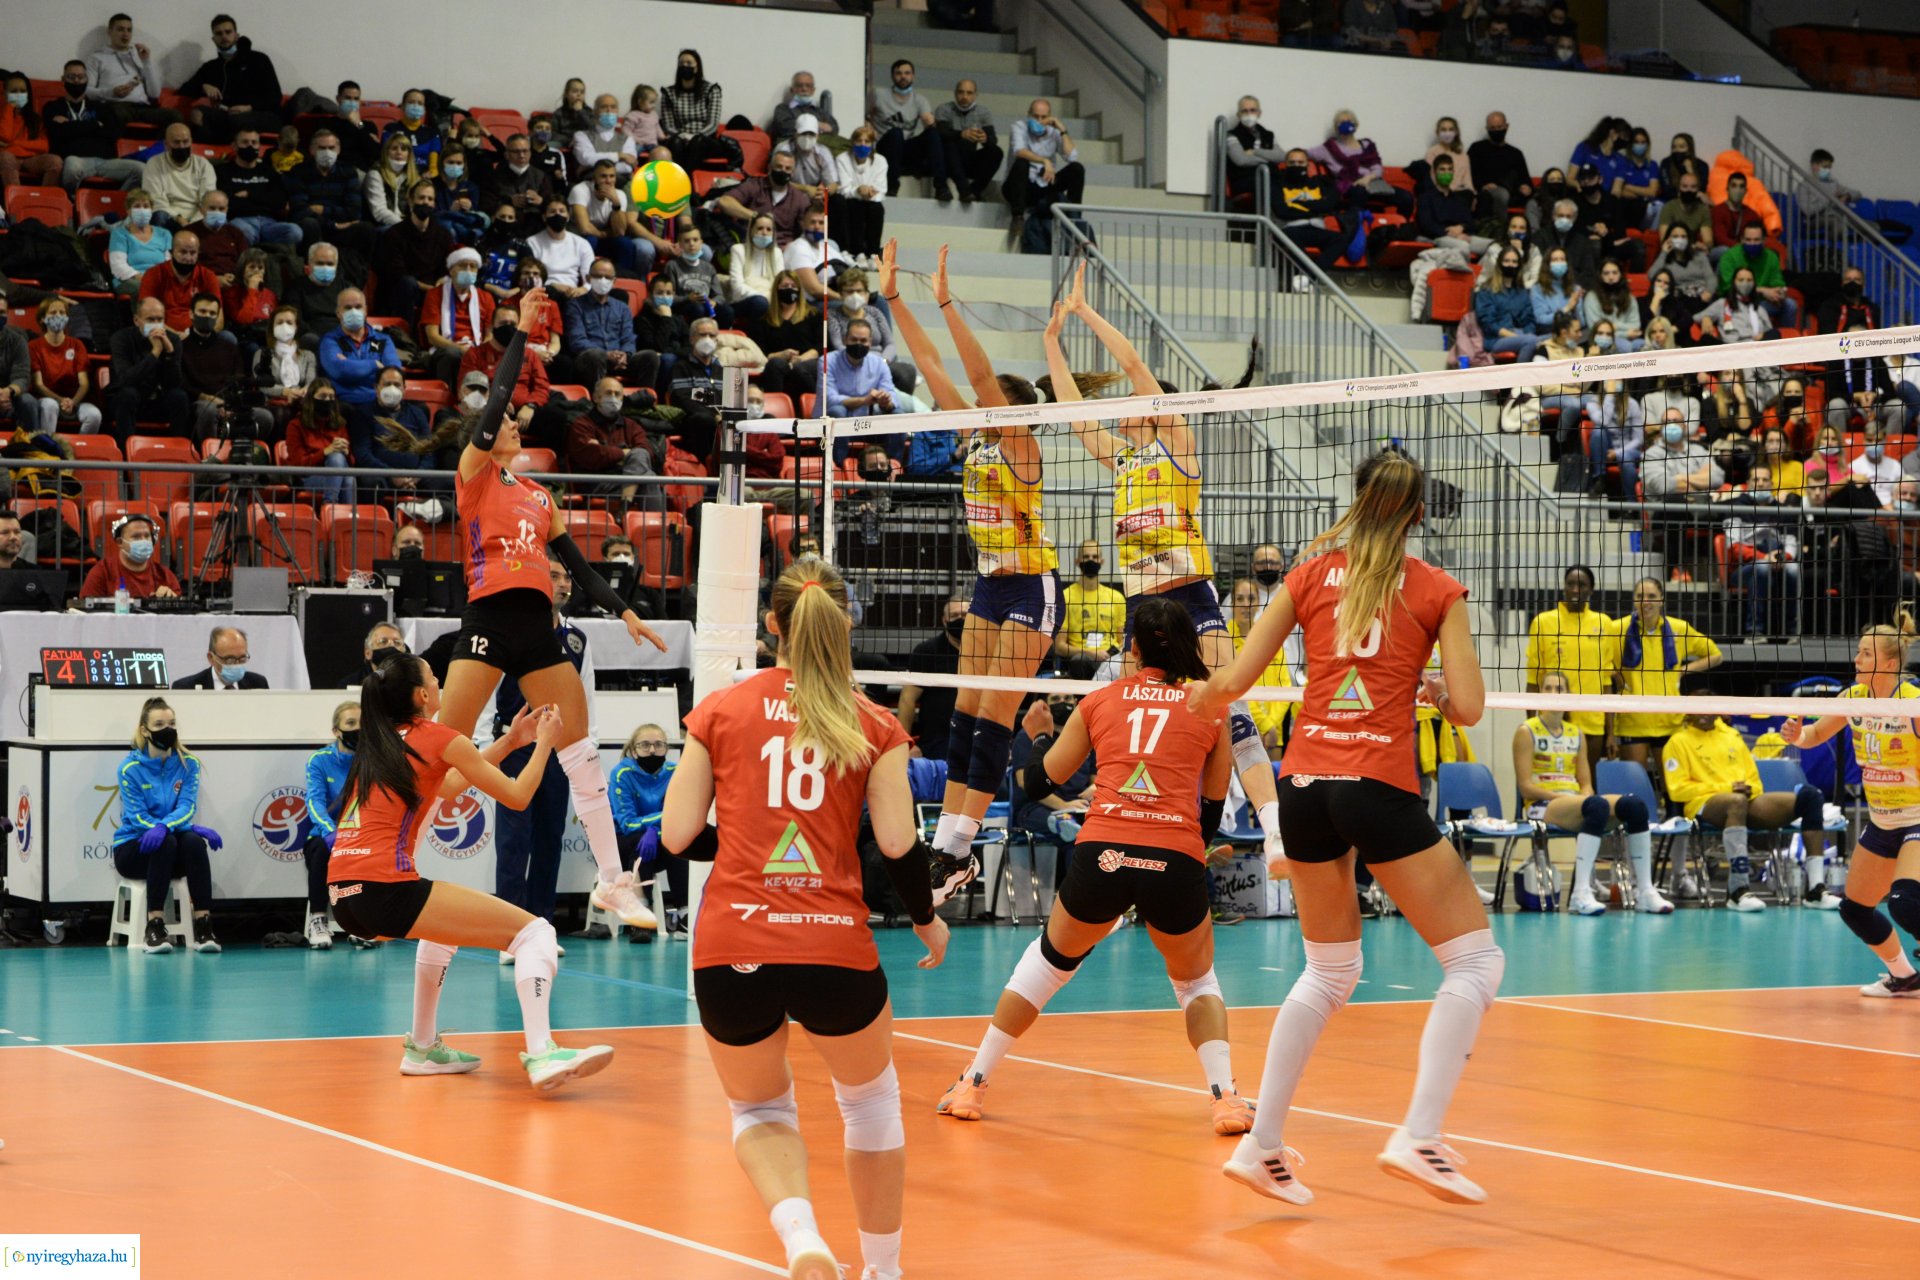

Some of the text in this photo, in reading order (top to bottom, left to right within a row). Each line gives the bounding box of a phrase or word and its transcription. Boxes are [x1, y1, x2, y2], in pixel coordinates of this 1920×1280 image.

[497, 258, 505, 274] 7
[1866, 338, 1893, 346] Champions
[1893, 336, 1912, 345] League
[518, 519, 536, 543] 12
[470, 634, 489, 656] 12
[43, 649, 83, 660] FATUM
[132, 650, 164, 660] Imoco
[102, 659, 109, 667] T
[56, 660, 161, 684] 4 11
[1122, 684, 1185, 703] LÁSZLOP
[1126, 707, 1170, 754] 17
[1323, 731, 1392, 743] BESTRONG
[1864, 732, 1882, 765] 14
[760, 735, 826, 811] 18
[271, 788, 308, 800] FATUM
[1120, 809, 1183, 823] BESTRONG
[764, 876, 822, 888] KE-VIZ 21
[1215, 873, 1256, 900] Sixtus
[767, 912, 854, 926] BESTRONG
